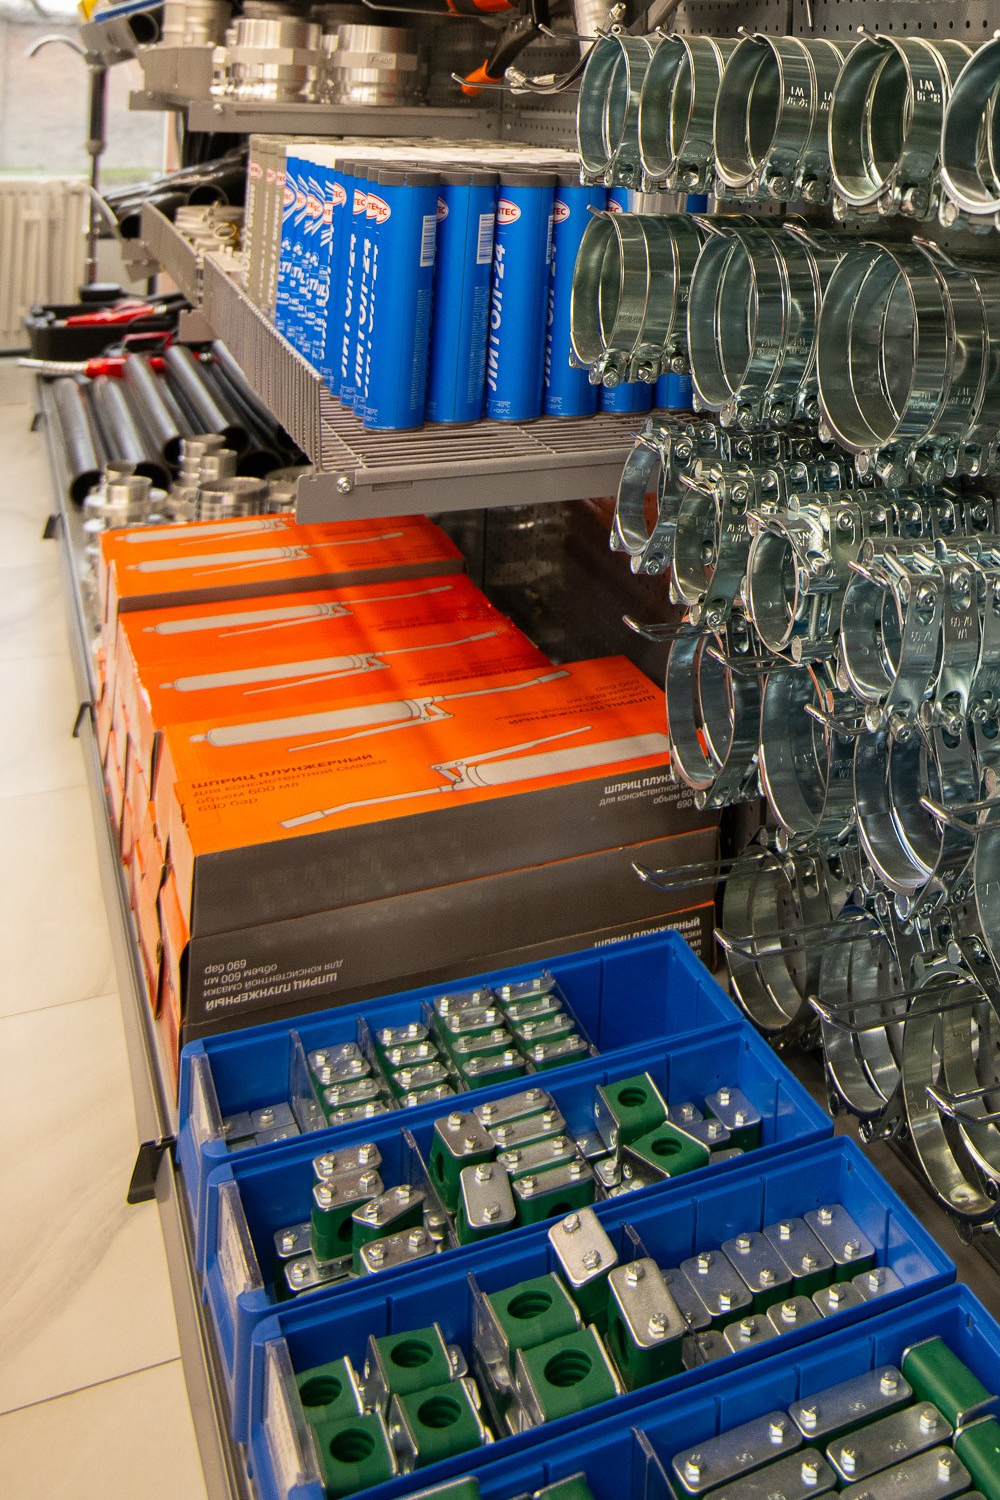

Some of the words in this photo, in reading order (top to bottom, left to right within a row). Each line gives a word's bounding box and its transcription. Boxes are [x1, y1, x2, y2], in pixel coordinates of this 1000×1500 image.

[919, 79, 935, 92] W1
[486, 243, 506, 392] ЛИТОЛ-24
[191, 772, 257, 790] ШПРИЦ
[260, 753, 373, 778] ПЛУНЖЕРНЫЙ
[224, 767, 334, 792] консистентной
[336, 759, 388, 773] смазки
[248, 784, 276, 796] 600
[279, 781, 300, 791] мл
[604, 779, 642, 795] ШПРИЦ
[599, 796, 616, 807] для
[617, 784, 680, 802] консистентной
[653, 793, 681, 805] объем
[198, 801, 227, 813] 690
[229, 797, 258, 808] бар
[677, 799, 693, 810] 690
[204, 963, 225, 974] бар
[227, 959, 247, 971] 690
[243, 963, 278, 978] объем
[324, 958, 344, 971] для
[204, 977, 219, 986] мл
[221, 971, 242, 984] 600
[244, 964, 322, 990] консистентной
[293, 972, 338, 990] ШПРИЦ
[203, 983, 243, 997] смазки
[205, 983, 291, 1012] ПЛУНЖЕРНЫЙ
